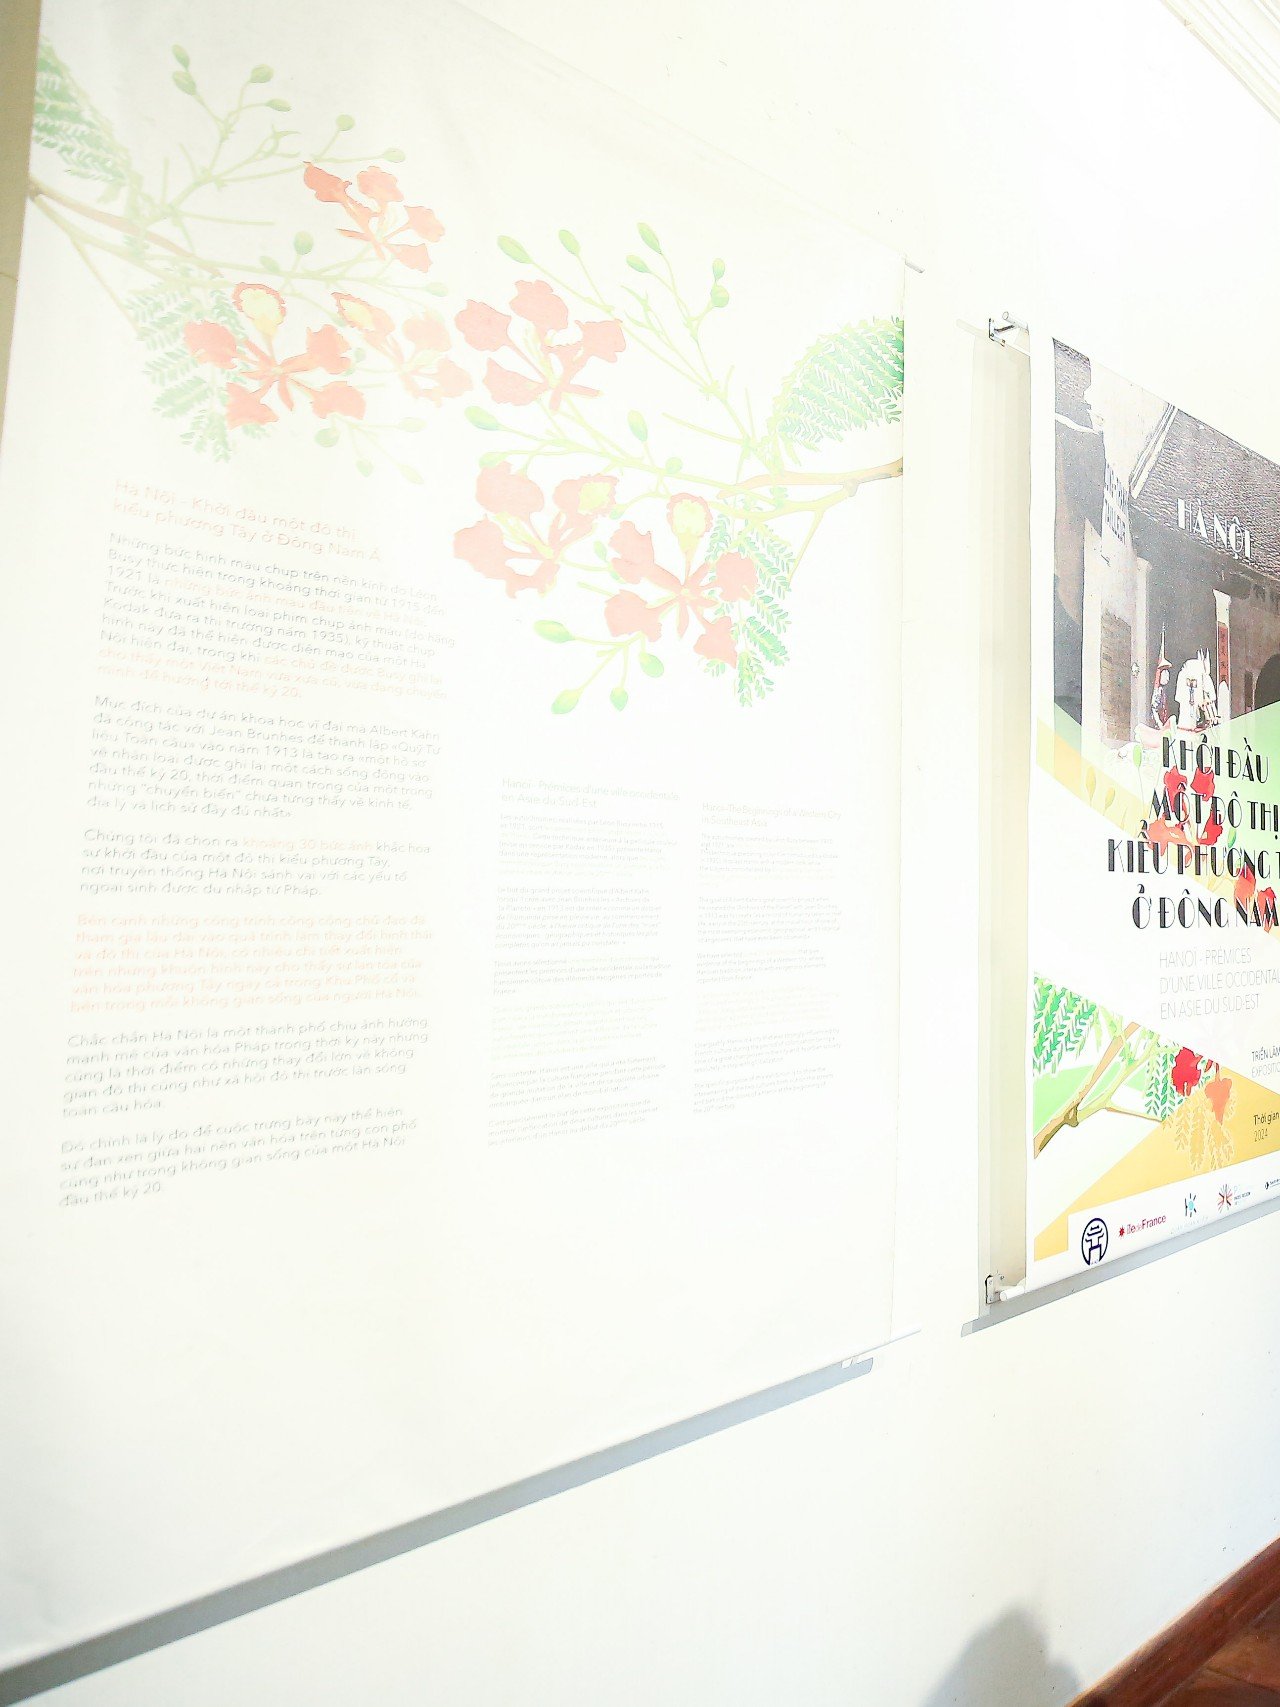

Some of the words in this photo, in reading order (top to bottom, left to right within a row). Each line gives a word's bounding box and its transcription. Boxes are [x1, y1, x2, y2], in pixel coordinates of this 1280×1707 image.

[1177, 497, 1208, 538] HÀ
[1213, 514, 1251, 559] NỘI
[1162, 733, 1220, 776] KHỞI
[1226, 737, 1269, 783] ĐẦU
[1149, 782, 1205, 831] MỘT
[1210, 791, 1243, 828] ĐÔ
[1247, 800, 1279, 840] THỊ
[1108, 819, 1168, 874] KIỂU
[1177, 843, 1271, 879] PHƯƠNG
[1132, 883, 1152, 929] Ở
[1158, 888, 1230, 929] ĐÔNG
[1235, 897, 1279, 927] NAM
[1205, 945, 1251, 965] PRÉMICES
[1160, 975, 1195, 994] D'UNE
[1197, 973, 1222, 990] VILLE
[1160, 1002, 1176, 1019] EN
[1179, 999, 1201, 1017] ASIE
[1204, 998, 1220, 1014] DU
[1222, 993, 1259, 1012] SUD-EST
[1253, 1128, 1269, 1142] 2024
[1267, 1110, 1280, 1125] gian
